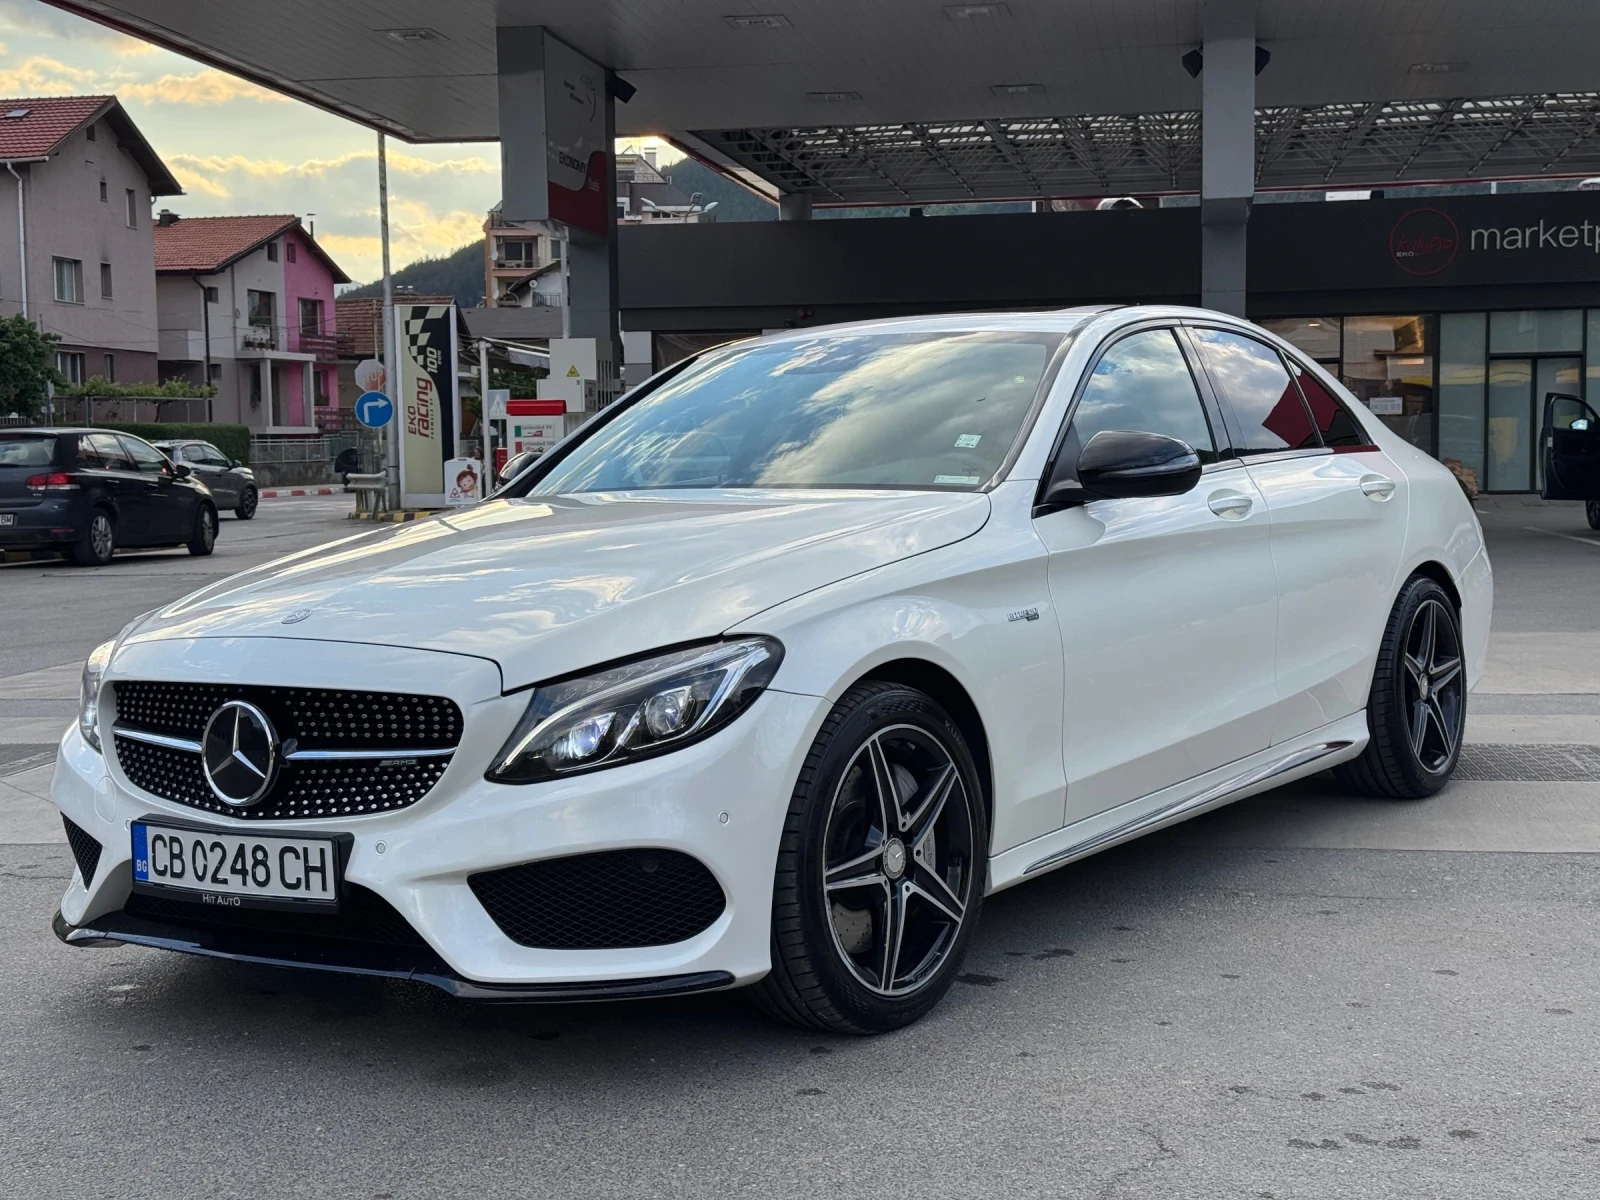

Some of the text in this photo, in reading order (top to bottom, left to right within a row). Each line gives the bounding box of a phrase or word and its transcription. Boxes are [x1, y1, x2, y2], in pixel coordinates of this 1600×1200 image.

[1471, 219, 1600, 253] market
[427, 347, 438, 374] 100
[407, 405, 417, 435] EKO
[416, 377, 433, 438] racing
[136, 859, 148, 873] BG
